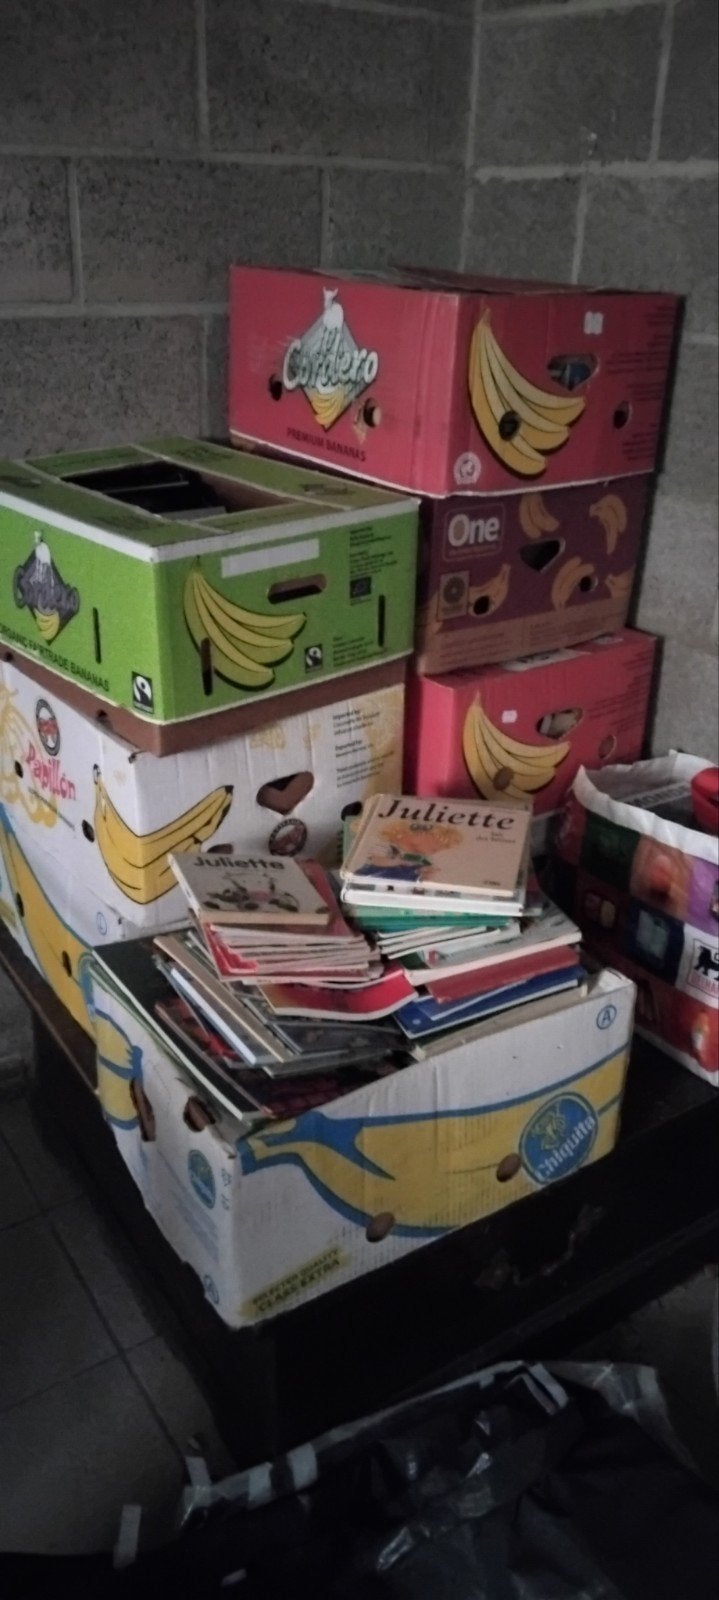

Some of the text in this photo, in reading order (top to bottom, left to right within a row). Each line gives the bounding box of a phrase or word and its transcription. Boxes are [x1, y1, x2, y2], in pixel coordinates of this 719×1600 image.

[287, 427, 366, 462] PREMIUM BANANAS
[448, 513, 500, 547] One
[70, 662, 110, 692] BANANAS
[378, 799, 515, 830] Juliette
[193, 856, 286, 870] Juliette
[534, 1116, 596, 1183] Chiquita
